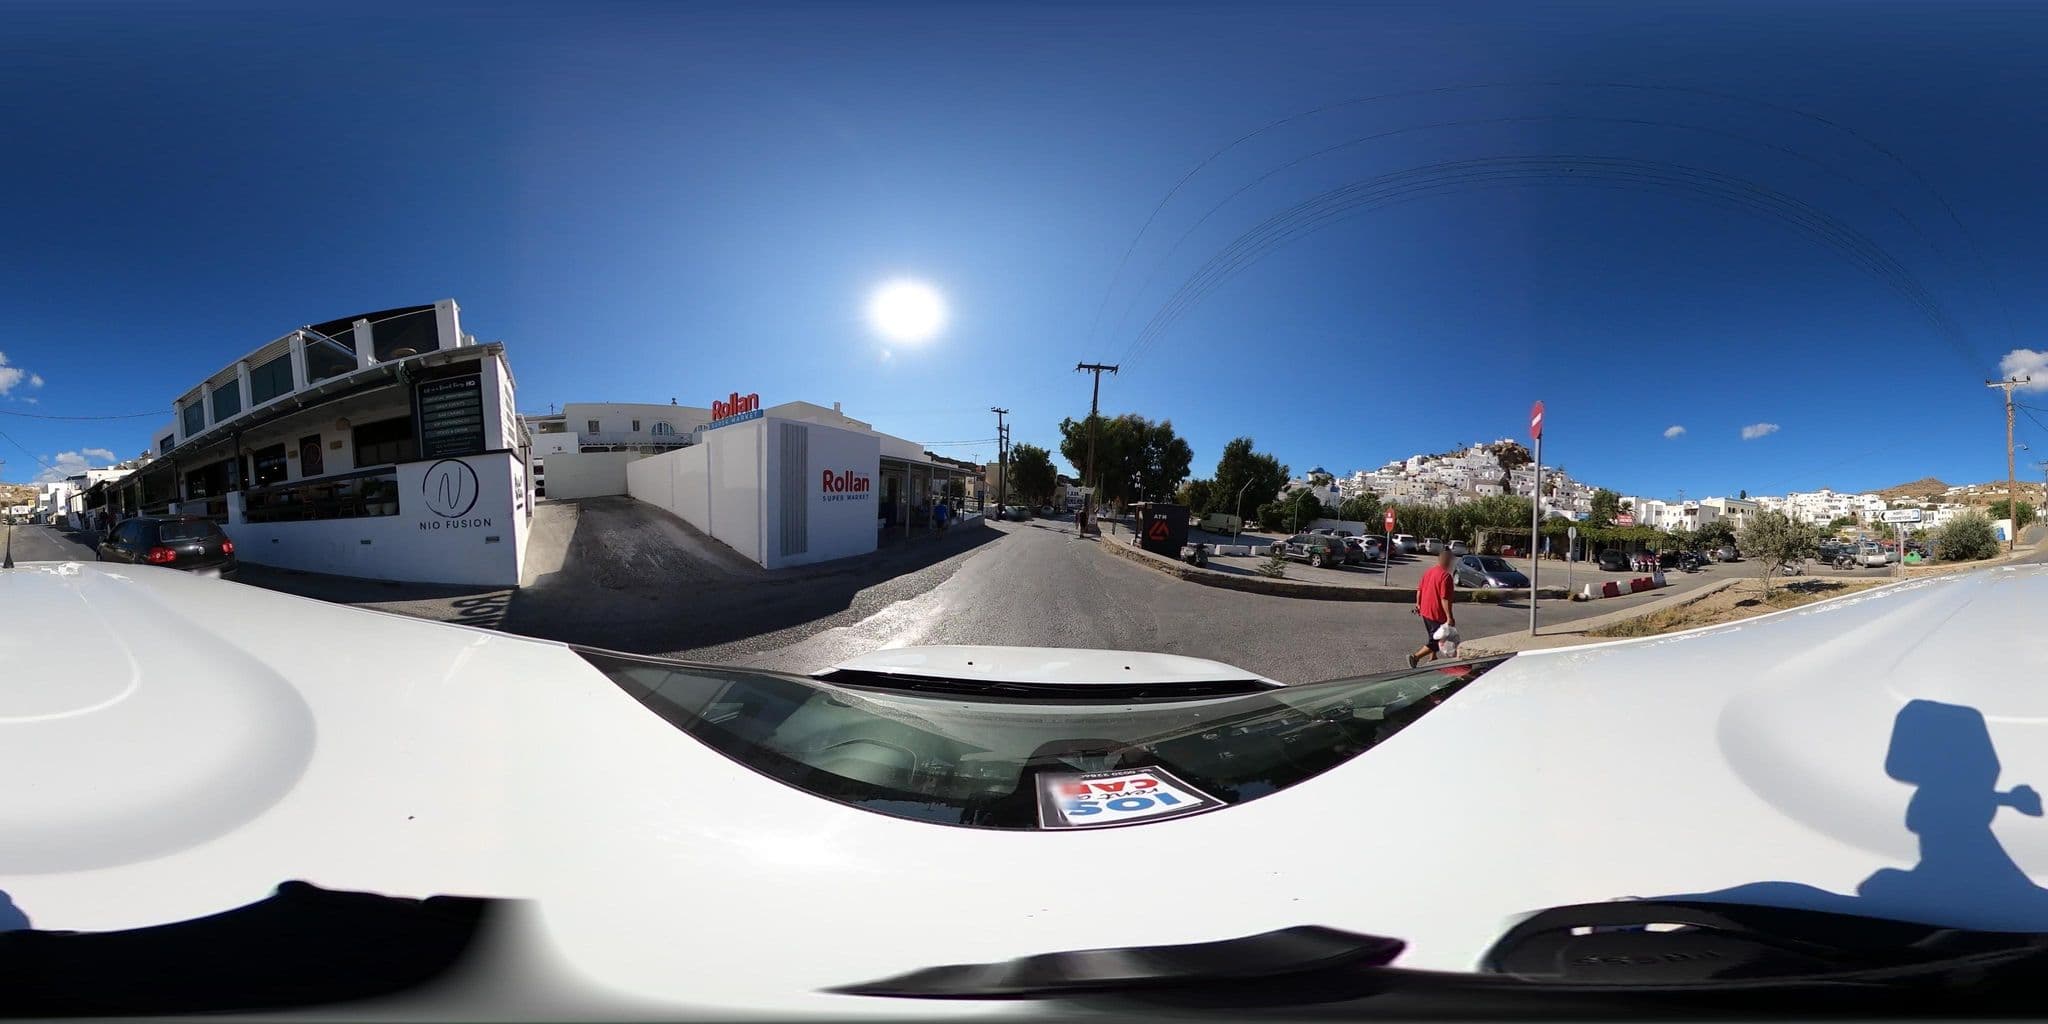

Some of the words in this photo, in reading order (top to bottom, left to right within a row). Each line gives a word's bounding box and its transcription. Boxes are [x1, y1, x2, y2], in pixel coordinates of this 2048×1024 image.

[712, 392, 759, 421] Rollan
[822, 469, 869, 492] Rollan
[419, 521, 441, 530] NIO
[446, 518, 491, 529] FUSION
[1097, 788, 1158, 799] rent
